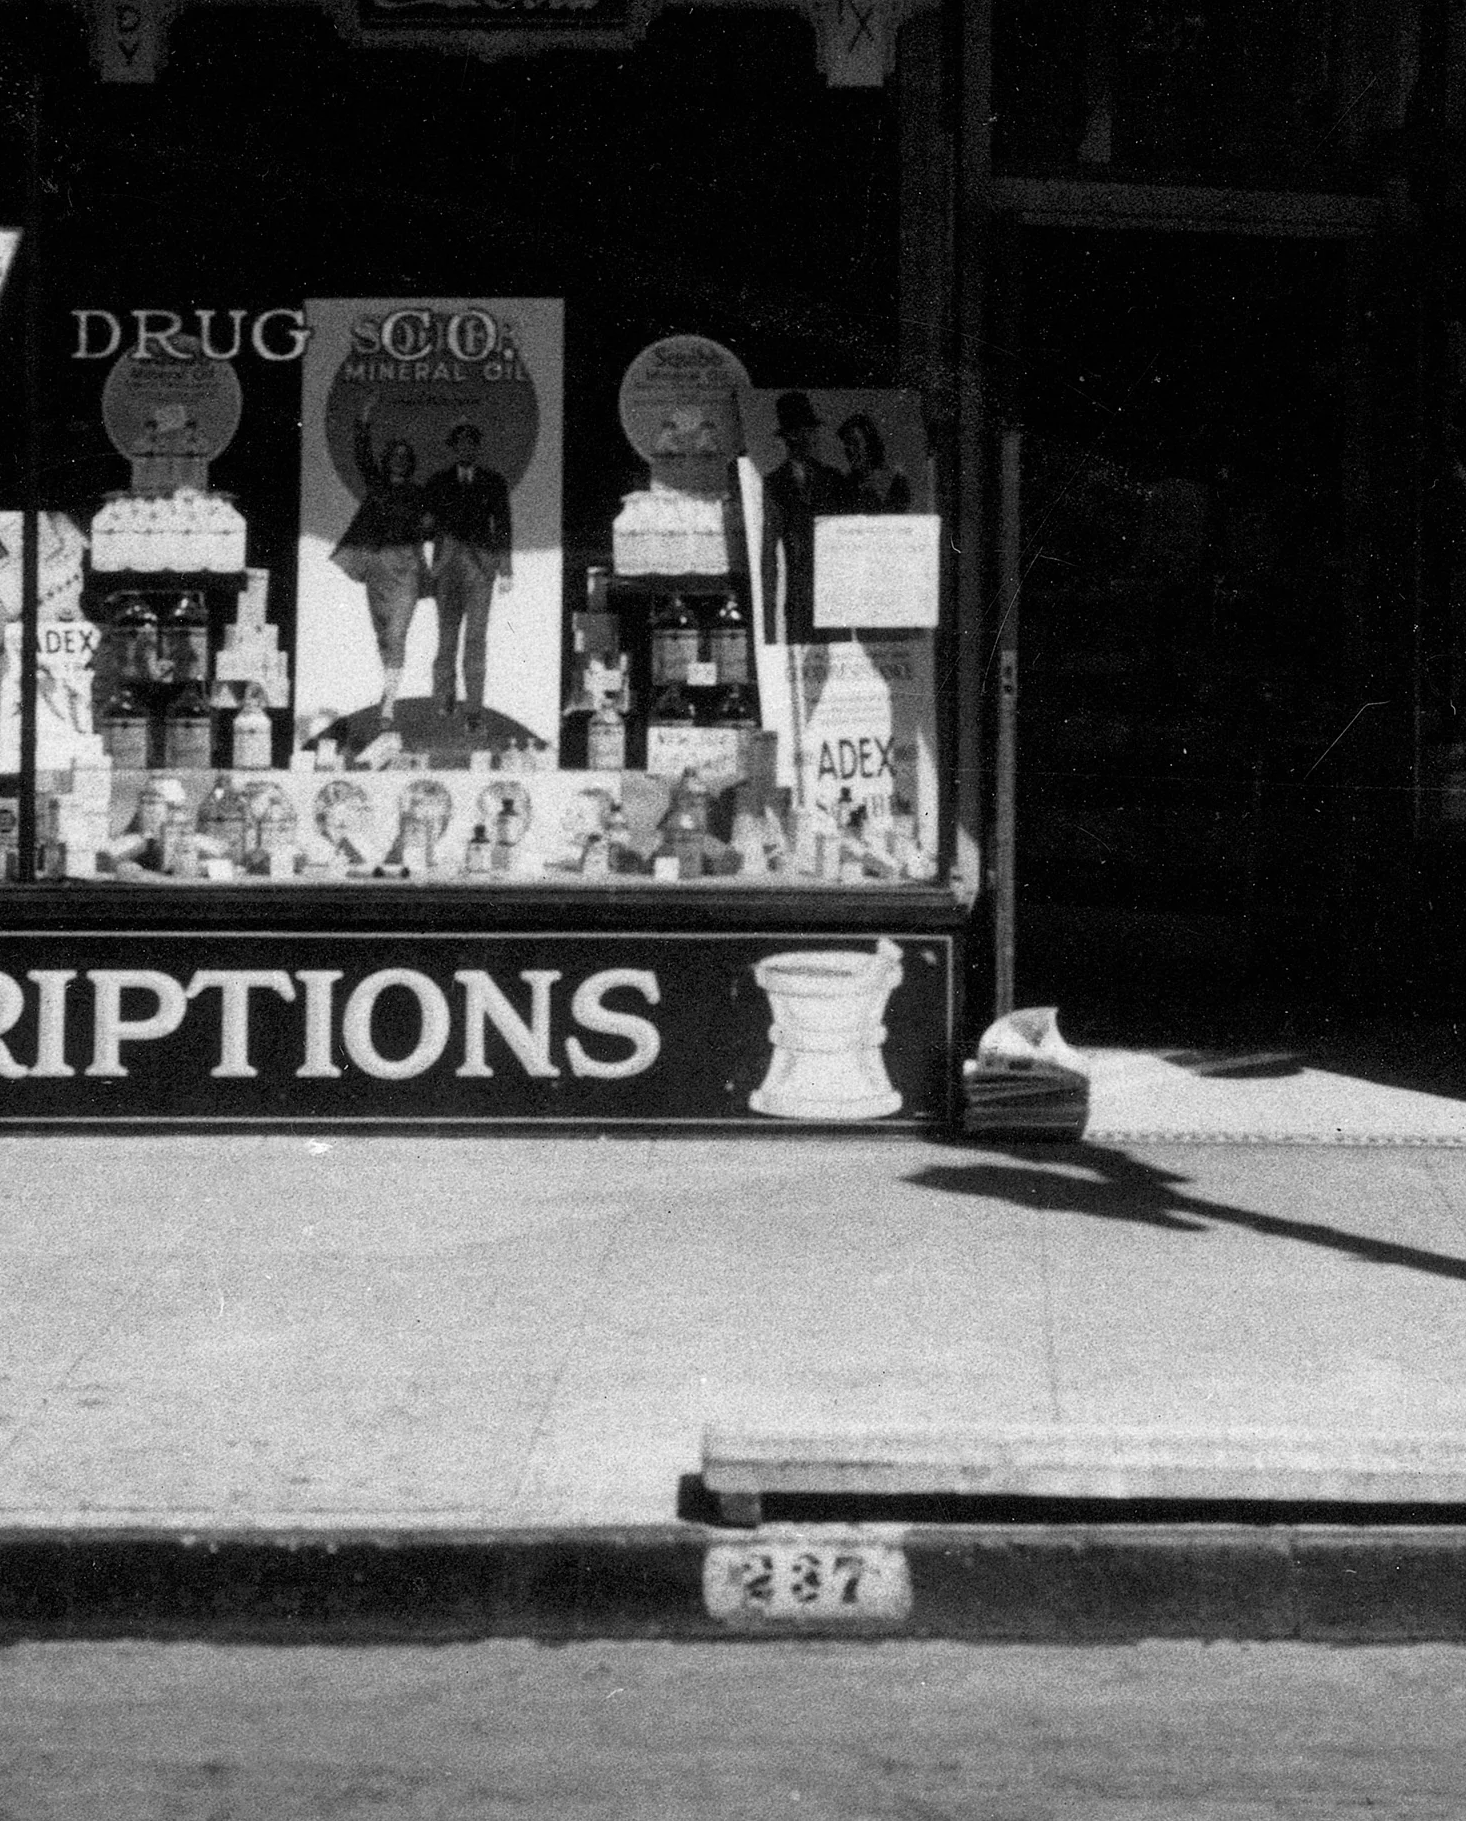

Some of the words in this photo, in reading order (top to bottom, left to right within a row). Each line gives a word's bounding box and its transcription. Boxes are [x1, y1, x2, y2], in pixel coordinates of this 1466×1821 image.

[71, 309, 311, 361] DRUG
[382, 309, 514, 361] CO.
[345, 361, 469, 382] MINERAL
[482, 361, 529, 382] OIL
[34, 630, 95, 654] DEX
[817, 737, 897, 780] ADEX
